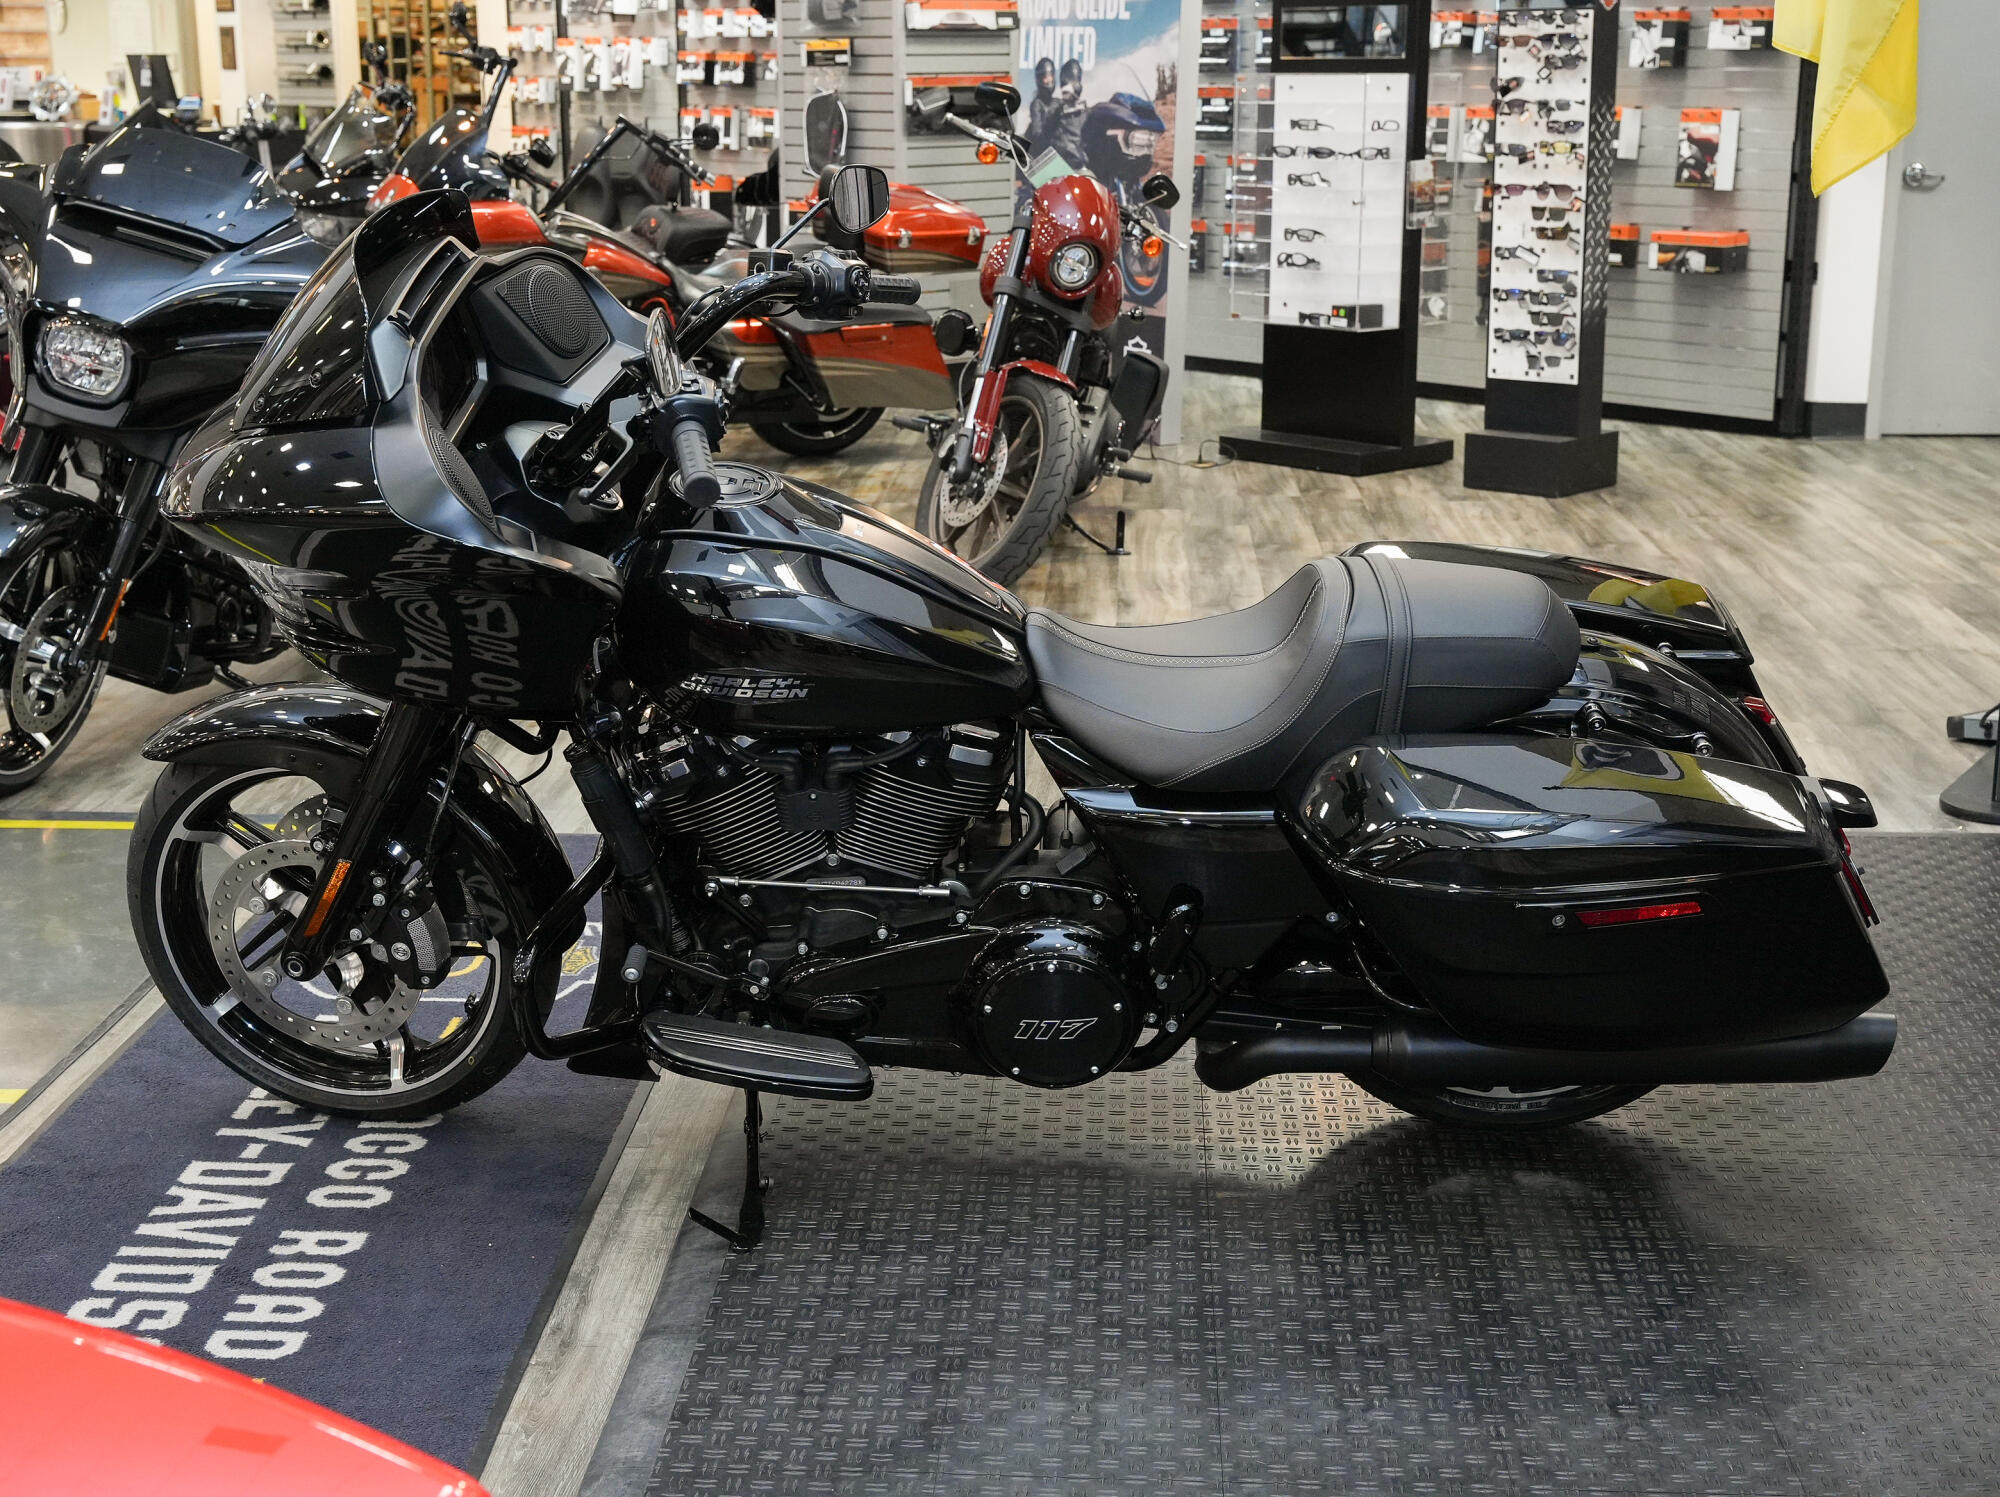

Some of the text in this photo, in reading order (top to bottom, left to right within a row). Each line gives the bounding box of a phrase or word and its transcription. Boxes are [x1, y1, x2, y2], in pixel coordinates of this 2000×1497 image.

[1019, 26, 1097, 71] LIMITED
[1013, 1017, 1099, 1040] 117
[203, 1230, 370, 1360] ROAD
